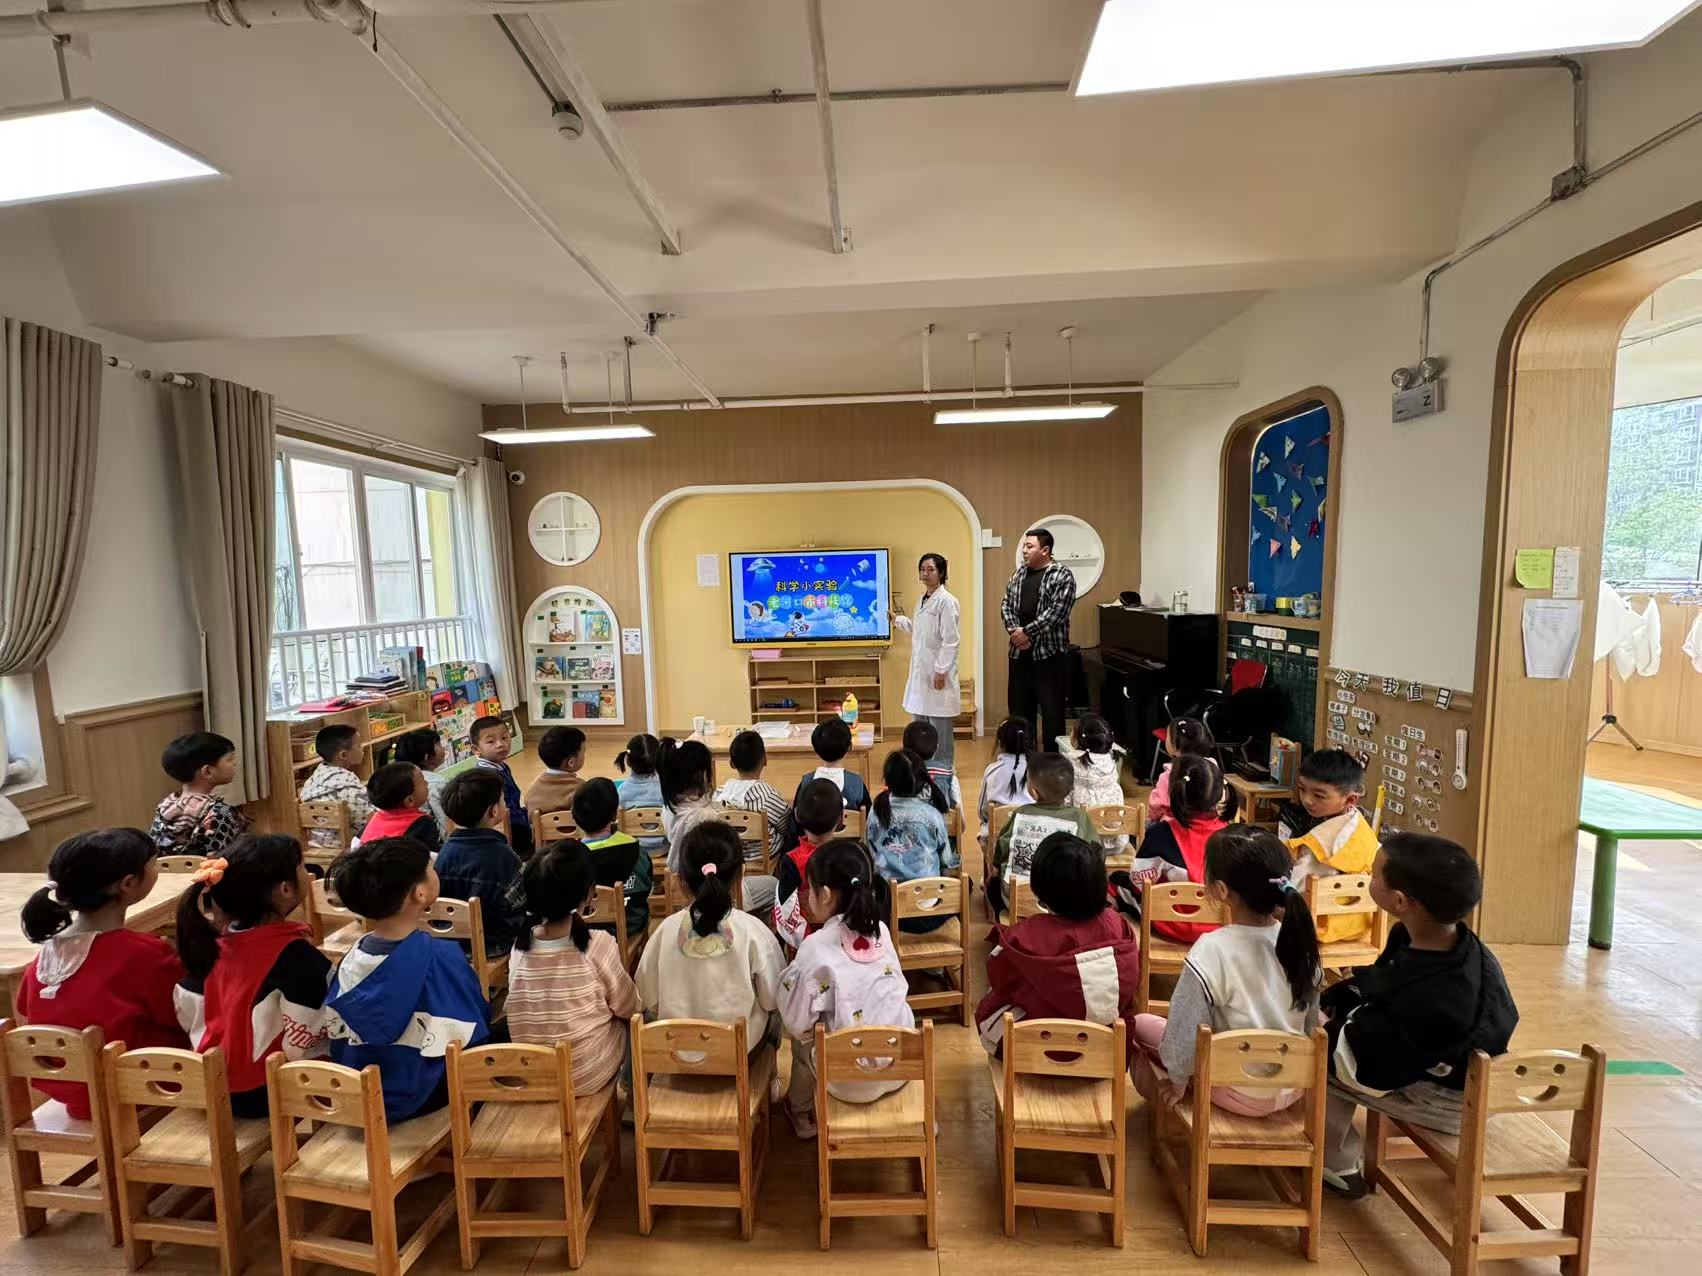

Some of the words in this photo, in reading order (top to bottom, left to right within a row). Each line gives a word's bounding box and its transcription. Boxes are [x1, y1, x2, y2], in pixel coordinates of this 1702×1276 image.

[775, 579, 838, 592] 科学小实验
